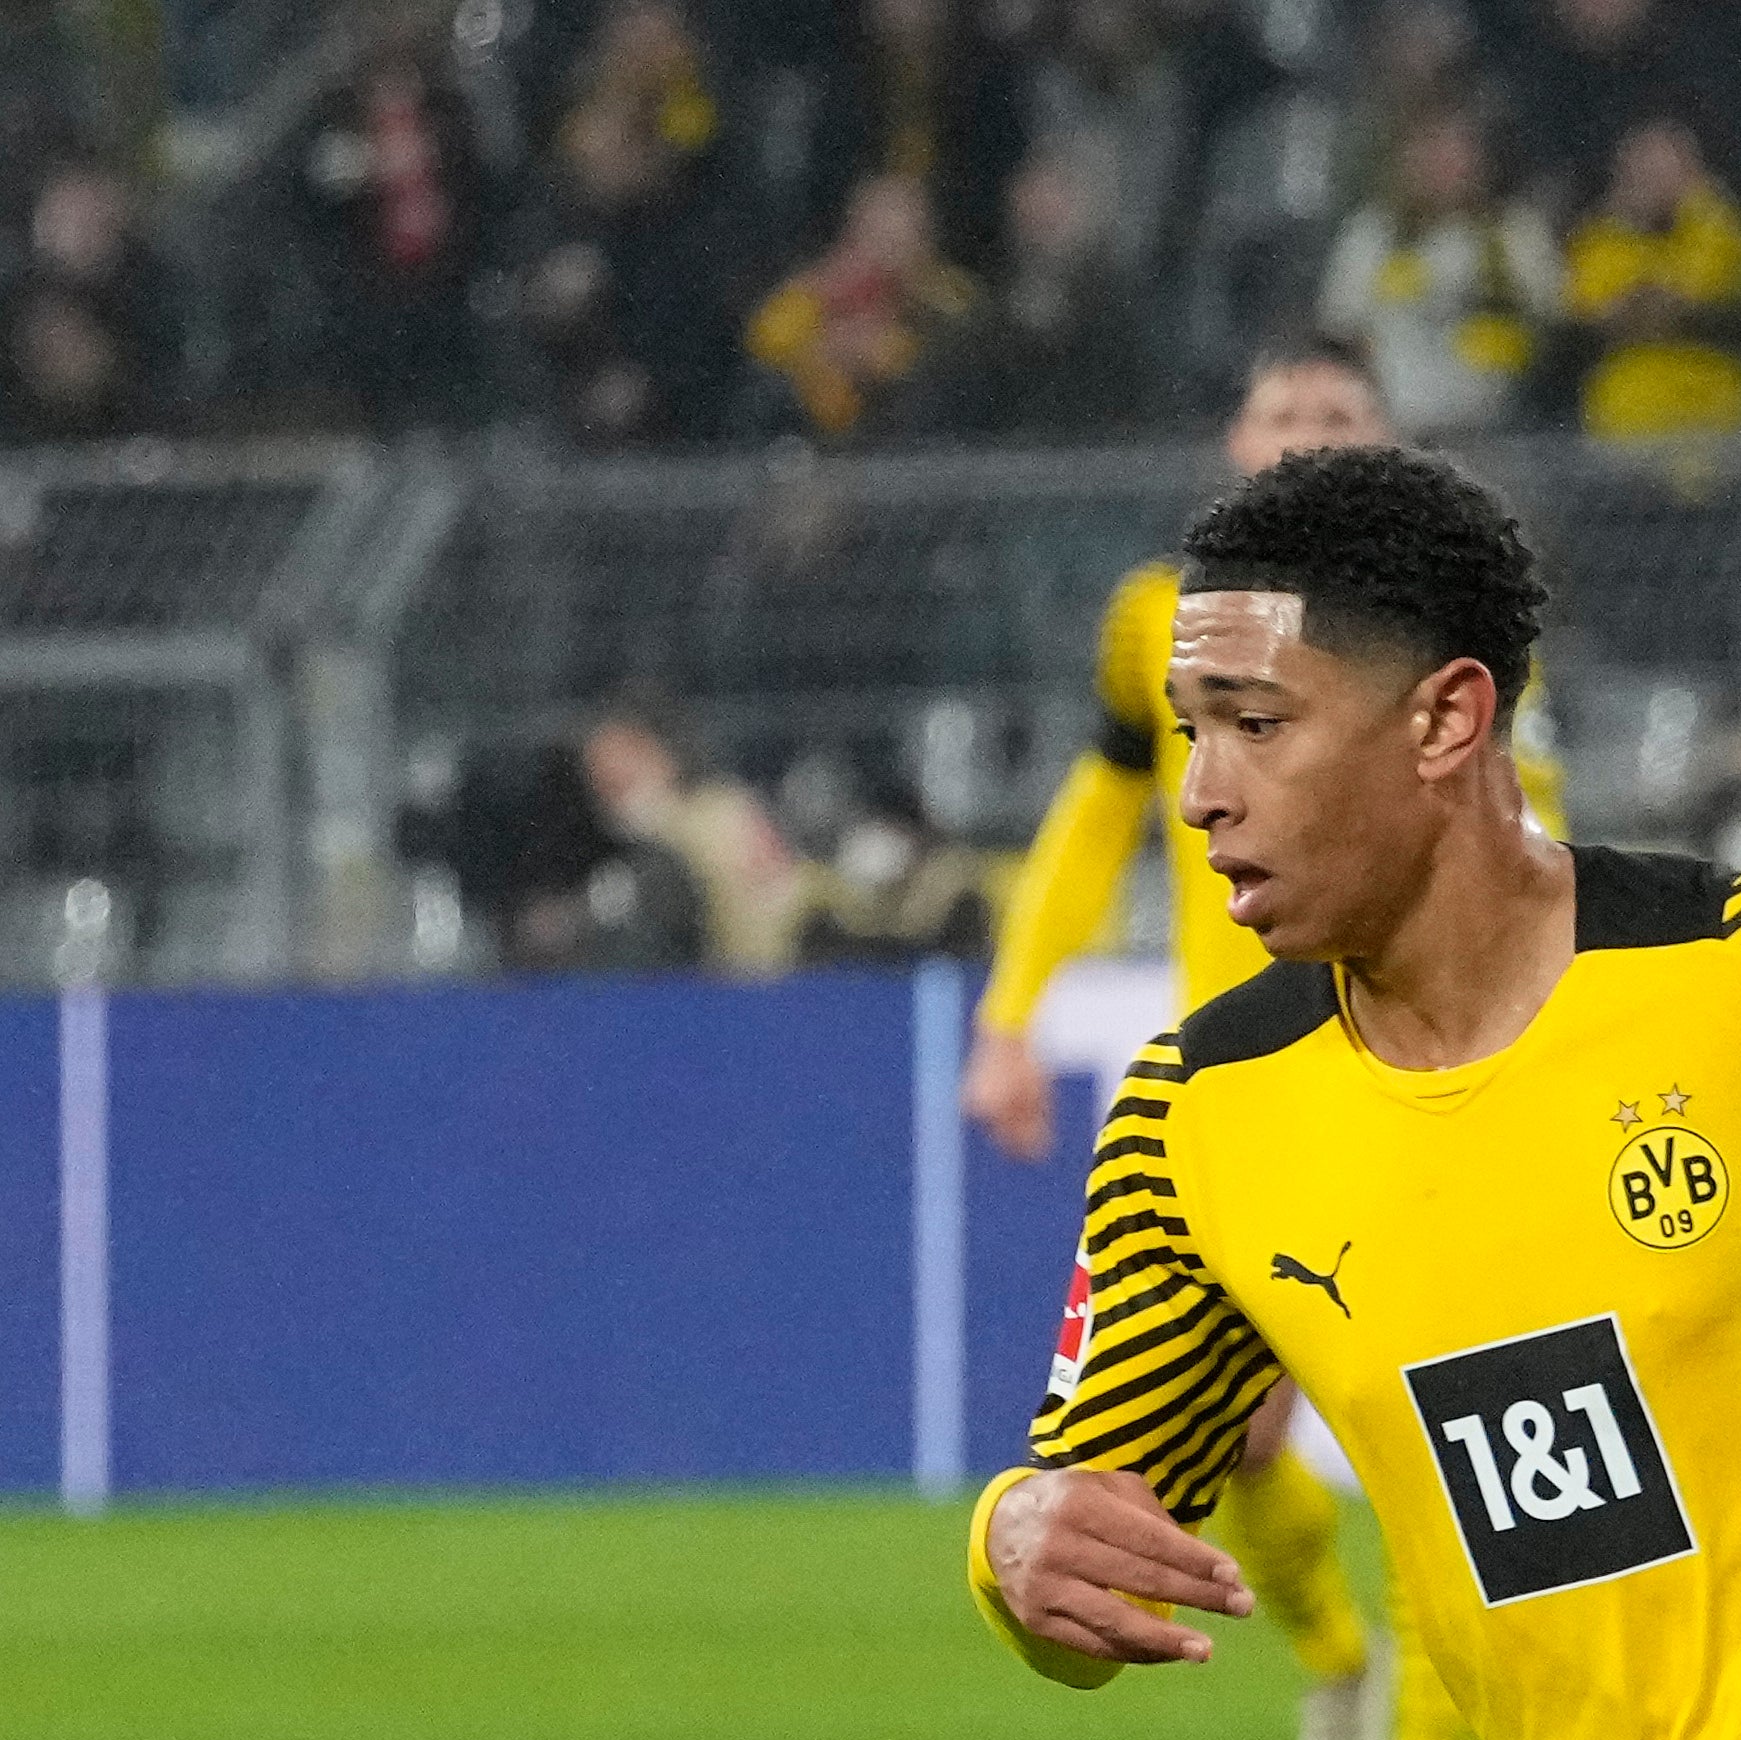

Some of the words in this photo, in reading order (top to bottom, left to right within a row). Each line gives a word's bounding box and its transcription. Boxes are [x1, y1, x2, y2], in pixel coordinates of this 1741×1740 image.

[1621, 1136, 1718, 1221] BVB
[1659, 1209, 1693, 1238] 09
[1441, 1382, 1643, 1532] 1&1
